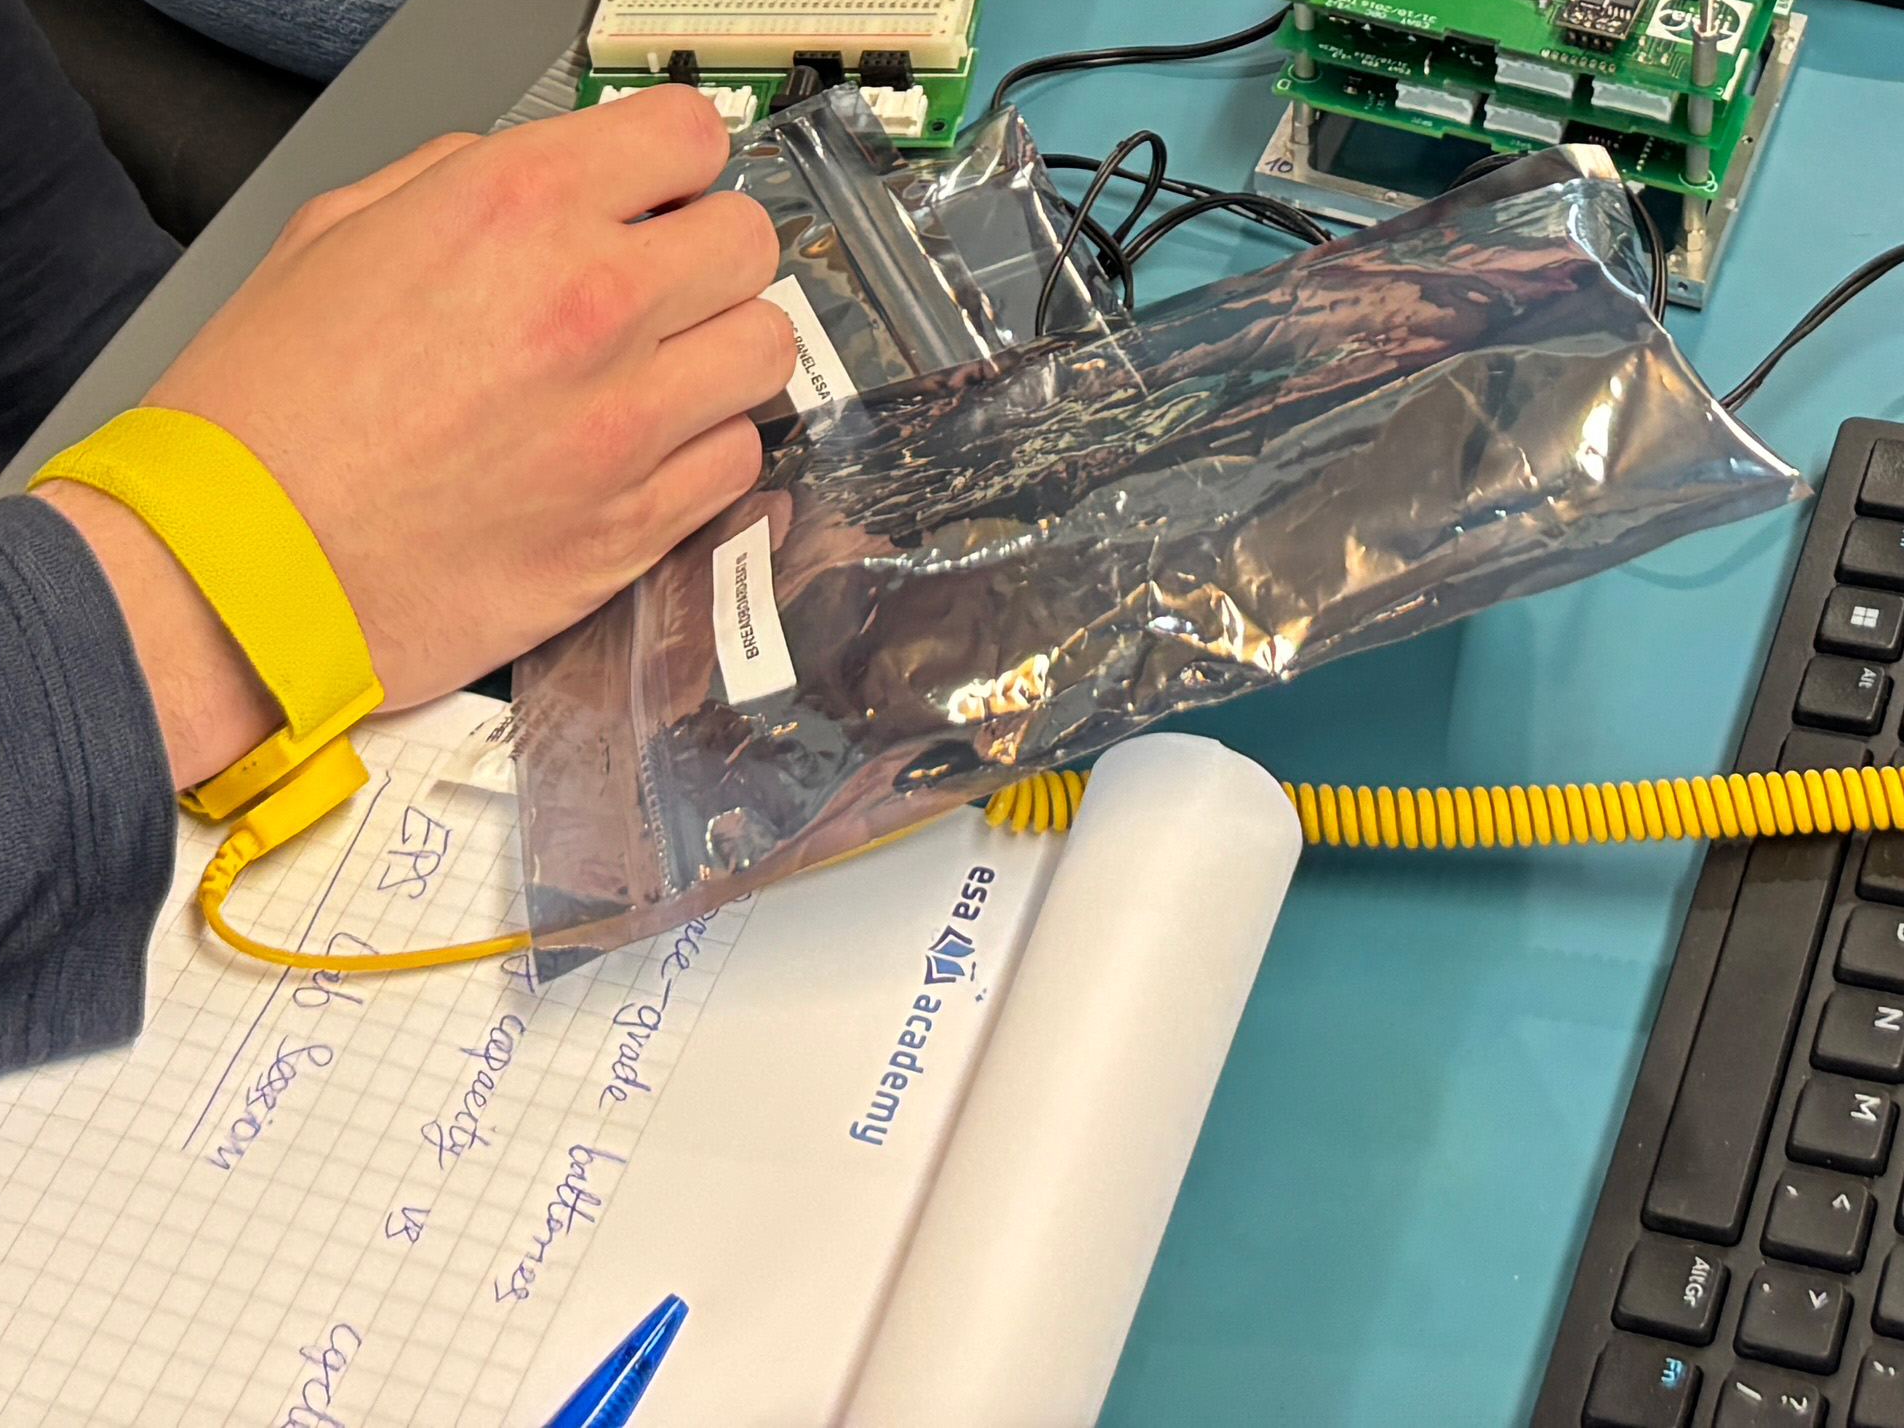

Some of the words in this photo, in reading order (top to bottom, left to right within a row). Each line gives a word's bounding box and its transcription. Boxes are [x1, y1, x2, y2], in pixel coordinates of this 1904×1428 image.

[1264, 155, 1294, 174] 10
[1860, 667, 1879, 688] Alt
[377, 805, 453, 900] EPS
[951, 865, 996, 922] esa
[1874, 1007, 1904, 1031] N
[848, 993, 943, 1147] academy
[1850, 1094, 1882, 1121] M
[1683, 1256, 1707, 1306] AltGr
[1661, 1356, 1684, 1386] Fn
